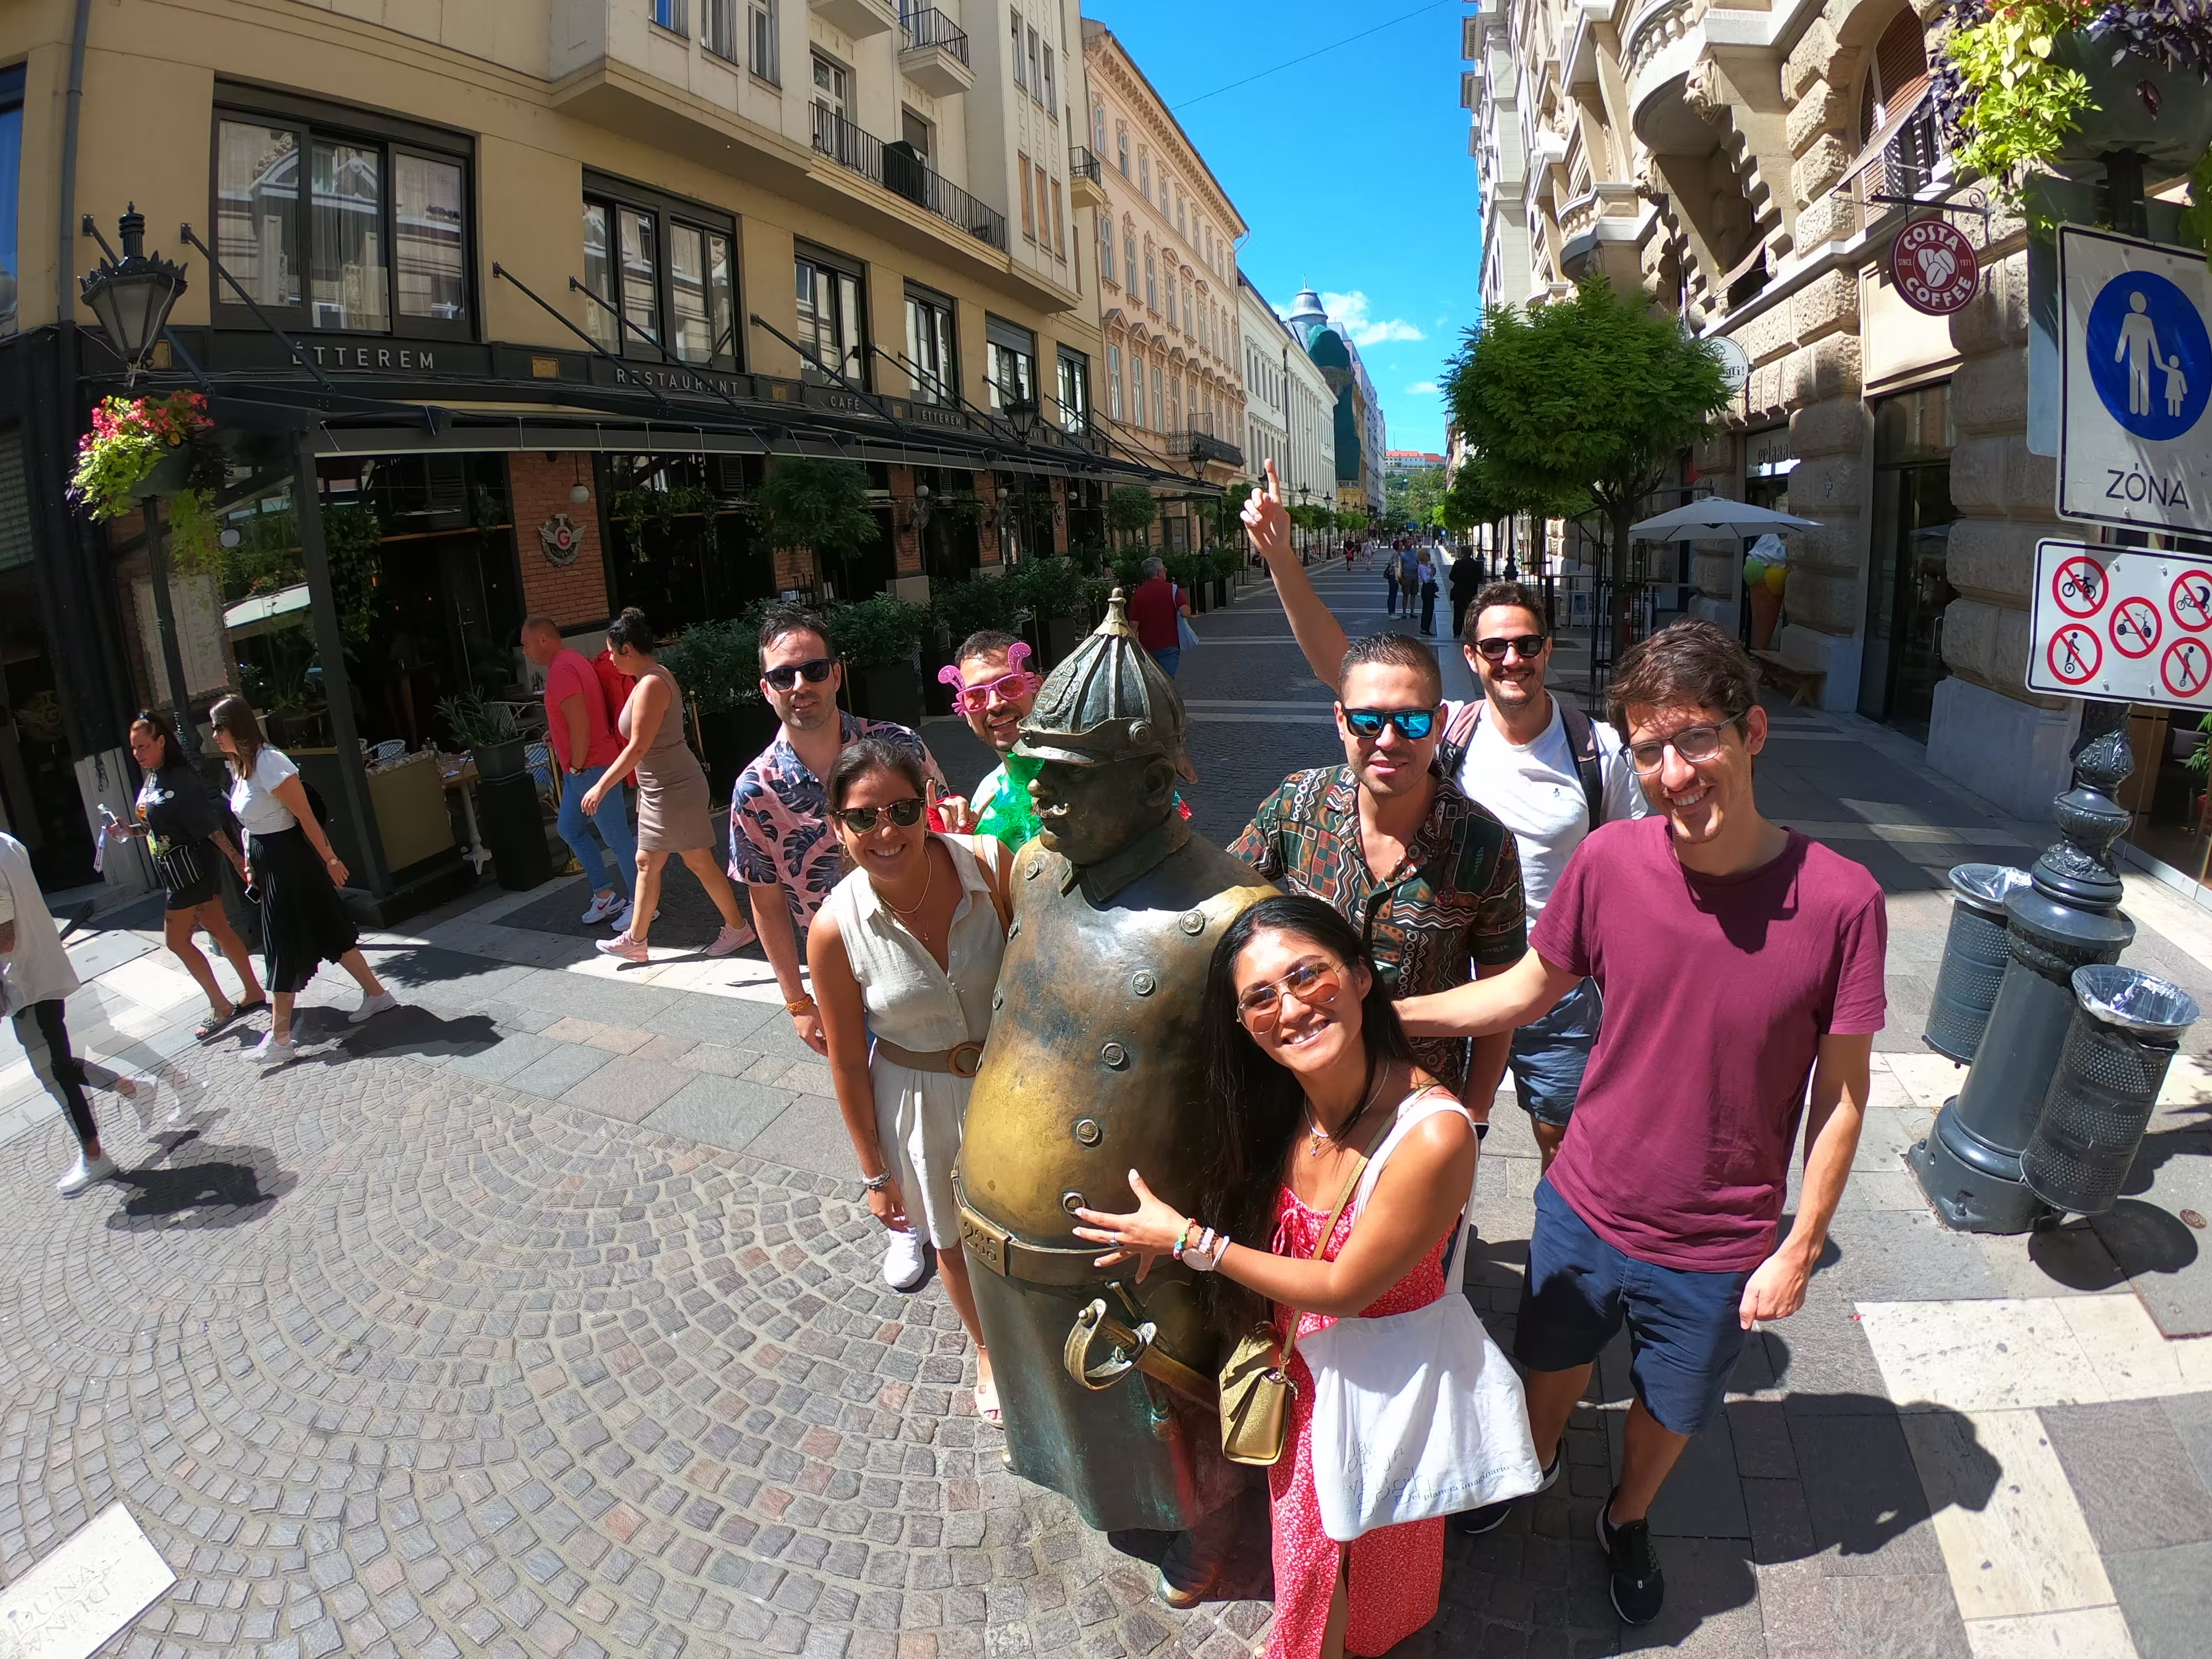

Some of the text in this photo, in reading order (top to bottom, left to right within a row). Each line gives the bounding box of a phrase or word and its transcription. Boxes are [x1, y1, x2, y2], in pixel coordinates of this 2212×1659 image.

[1903, 225, 1958, 252] COSTA
[1906, 276, 1972, 307] COFFEE
[616, 368, 738, 394] RESTAURANT
[830, 396, 860, 410] CAFÉ
[922, 409, 962, 426] ÉTTEREM
[2105, 463, 2189, 510] ZÓNA
[964, 1221, 998, 1262] 235
